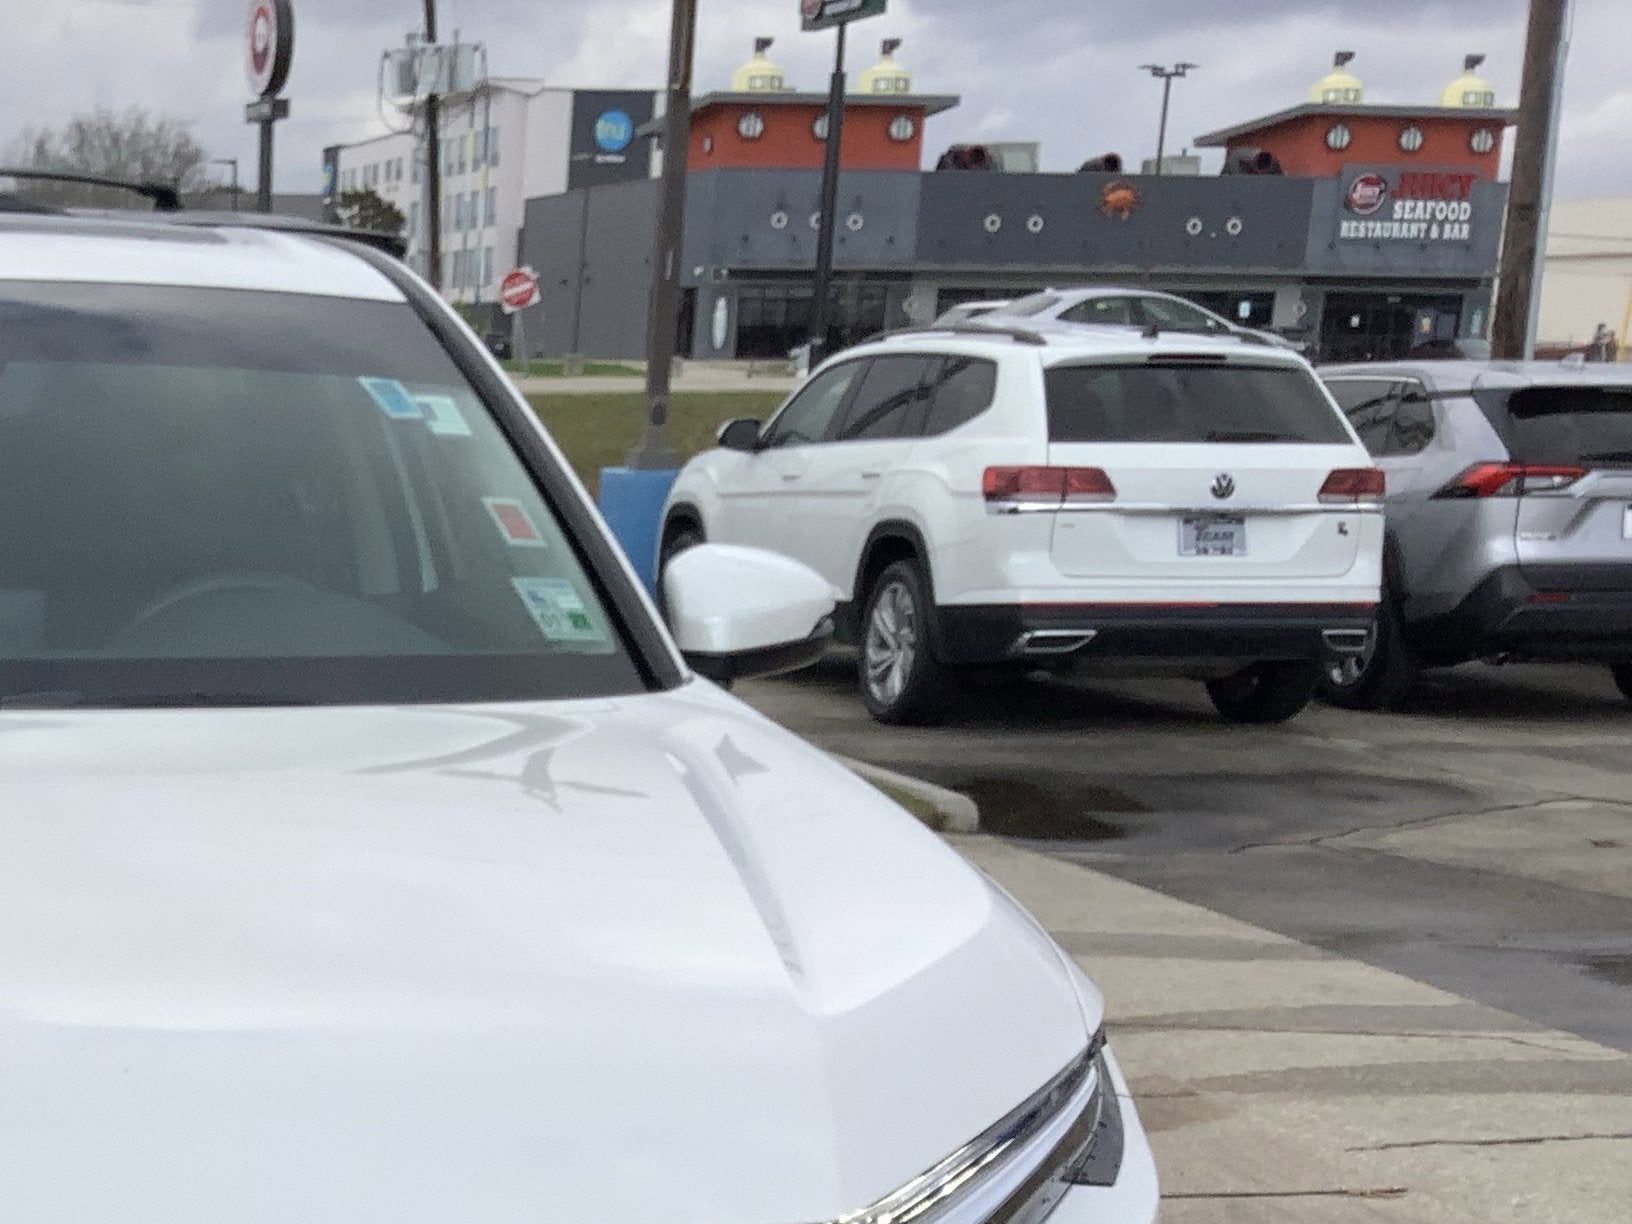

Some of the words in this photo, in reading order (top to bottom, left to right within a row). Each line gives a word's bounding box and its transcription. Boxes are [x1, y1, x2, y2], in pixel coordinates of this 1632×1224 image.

[1391, 172, 1474, 200] JUICY
[1393, 199, 1472, 221] SEAFOOD
[1339, 219, 1428, 239] RESTAURANT
[1442, 222, 1470, 240] BAR
